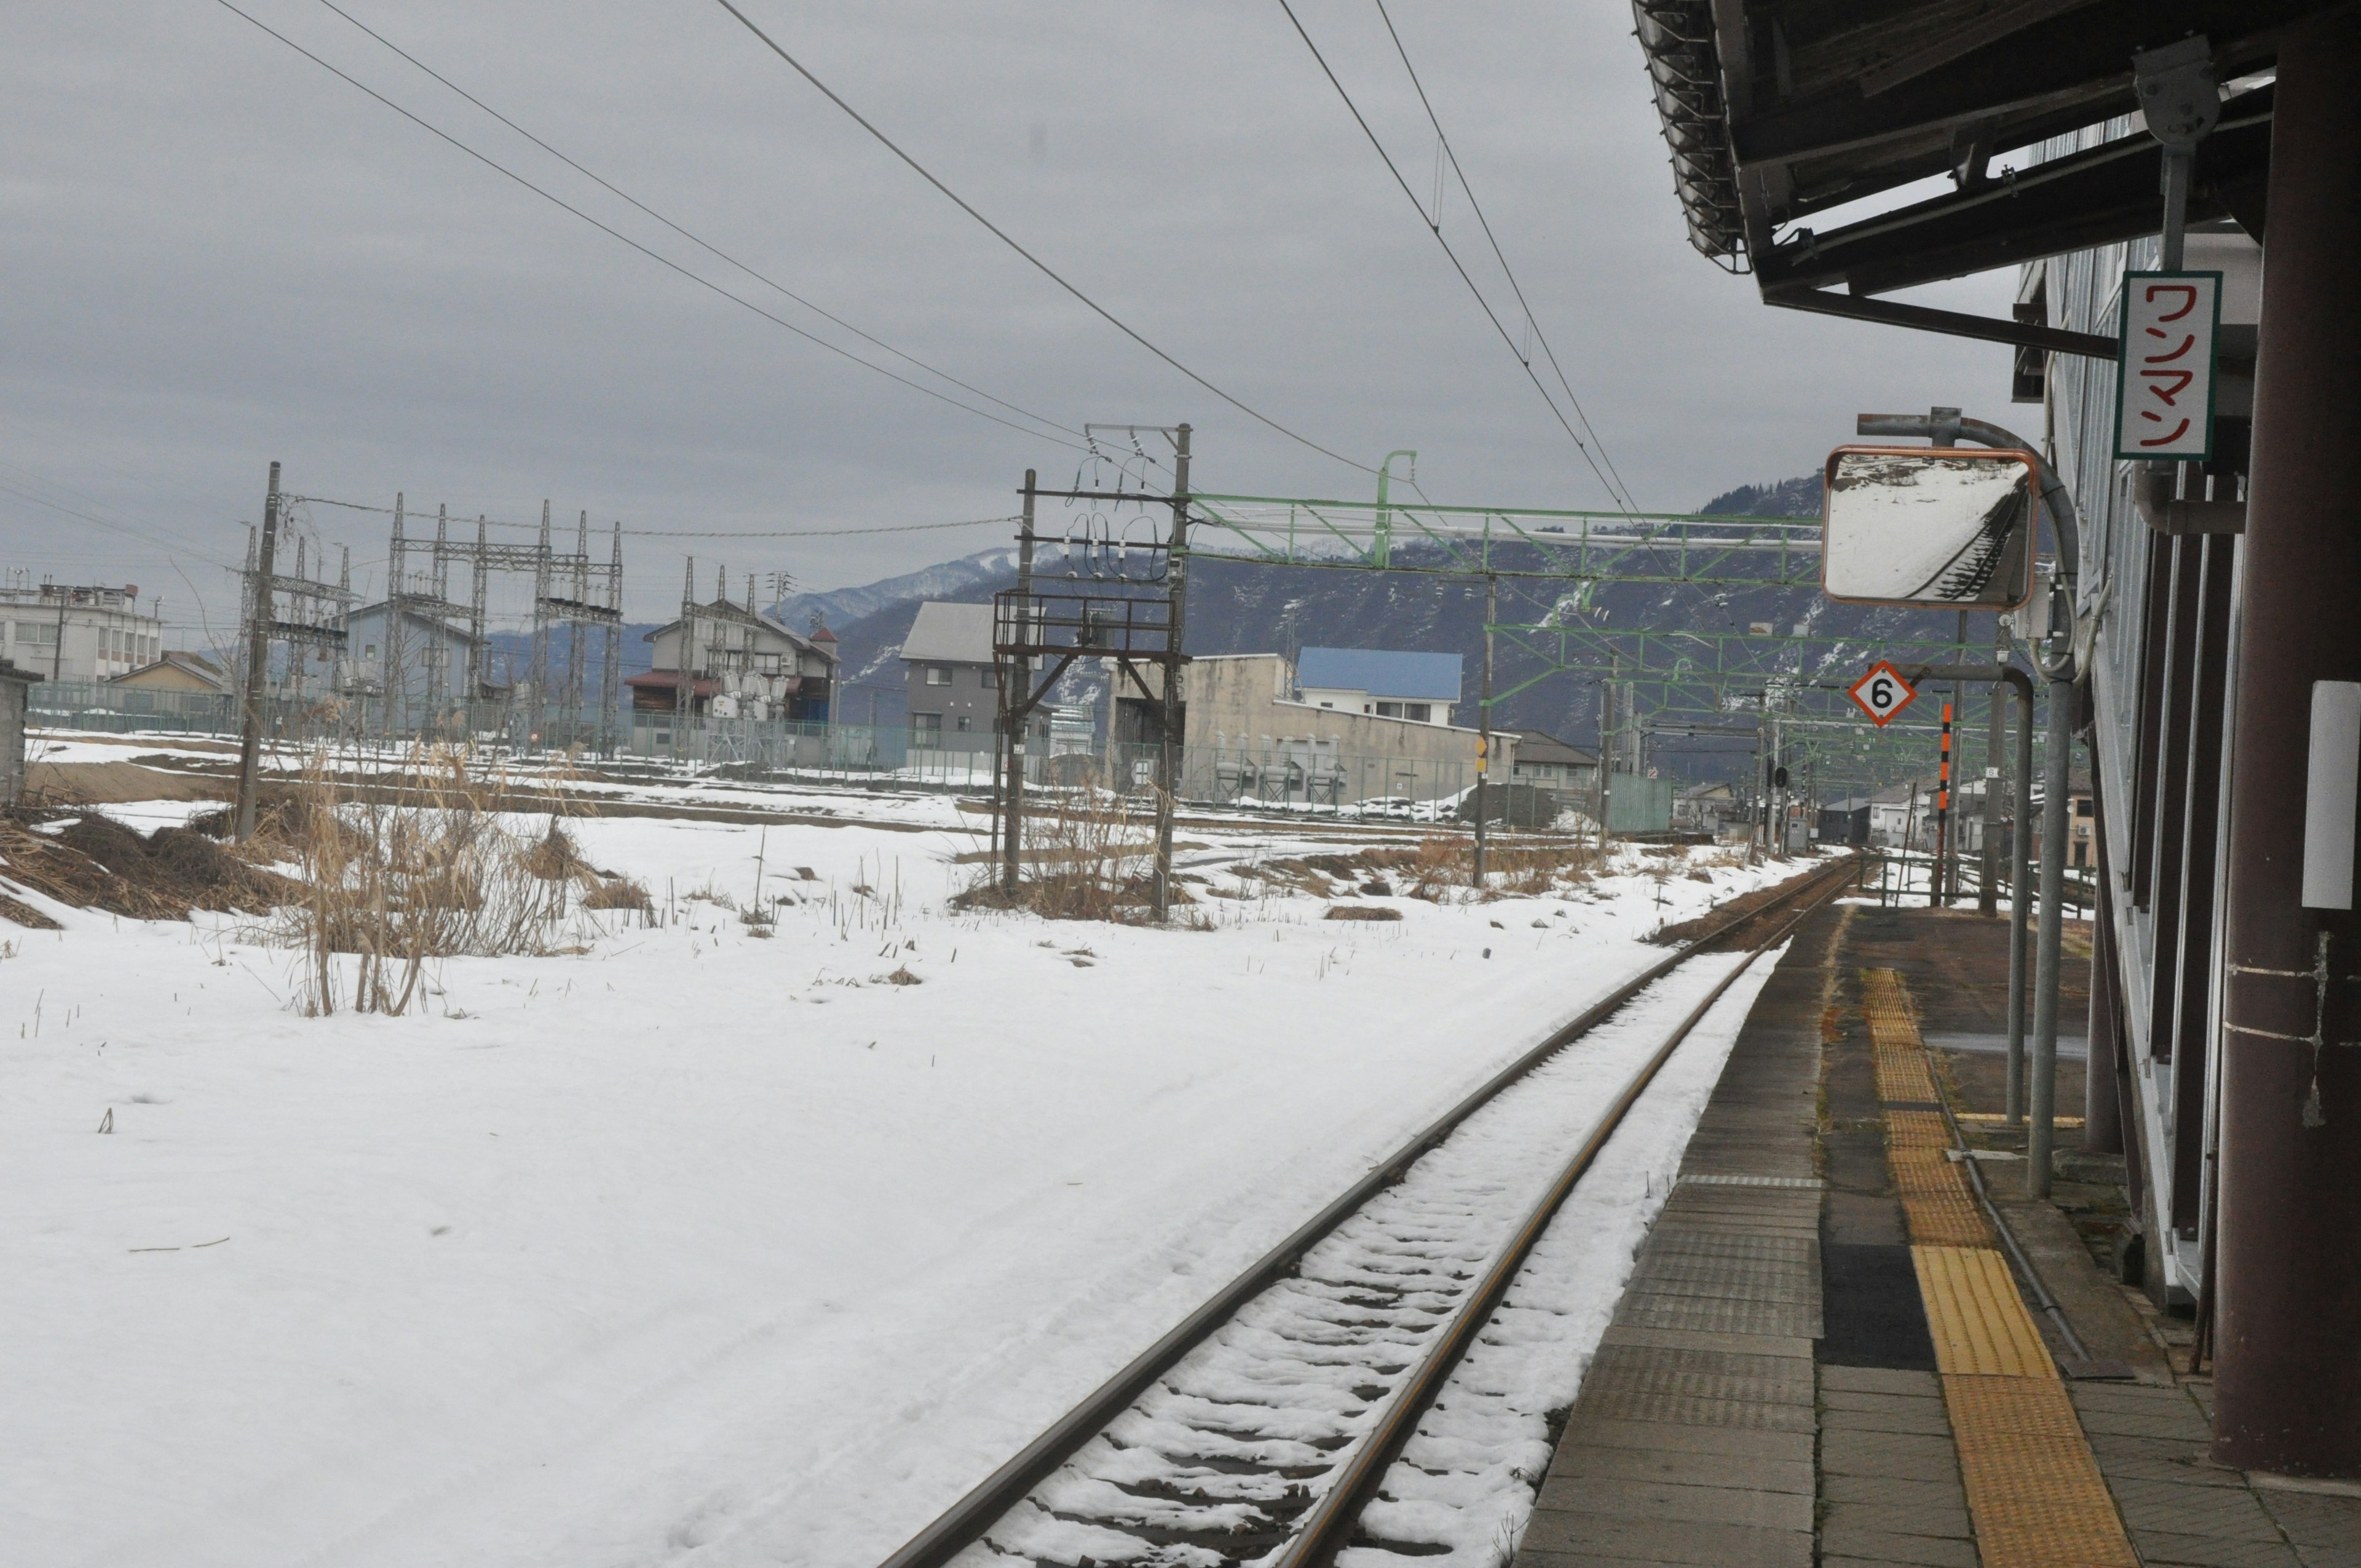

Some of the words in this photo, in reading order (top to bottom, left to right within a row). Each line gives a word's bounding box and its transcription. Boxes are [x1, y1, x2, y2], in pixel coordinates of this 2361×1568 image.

[2140, 285, 2197, 446] ワンマン
[1872, 678, 1893, 708] 6
